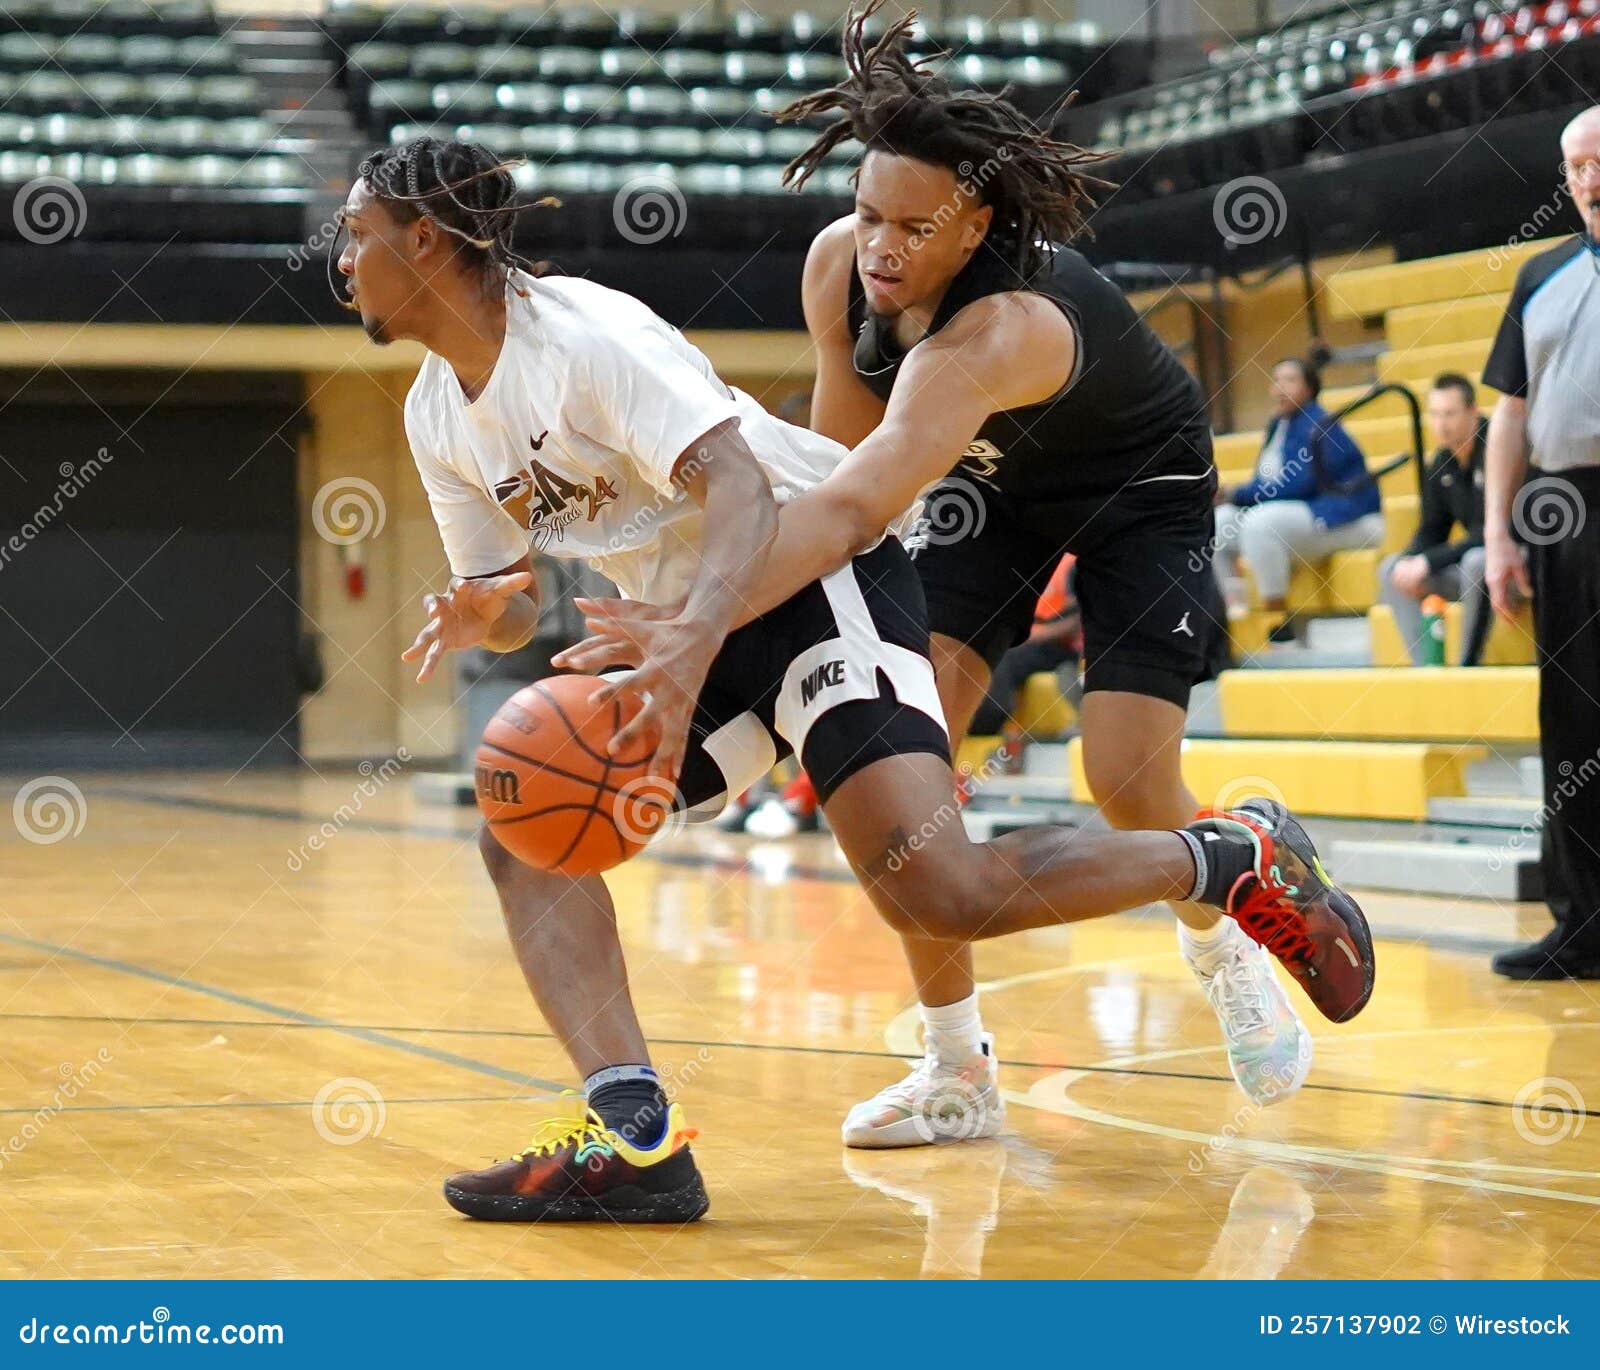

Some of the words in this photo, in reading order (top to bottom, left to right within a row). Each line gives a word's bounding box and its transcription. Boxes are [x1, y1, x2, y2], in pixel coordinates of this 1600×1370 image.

[528, 500, 584, 552] Squad
[575, 475, 619, 522] 24
[800, 659, 845, 708] NIKE
